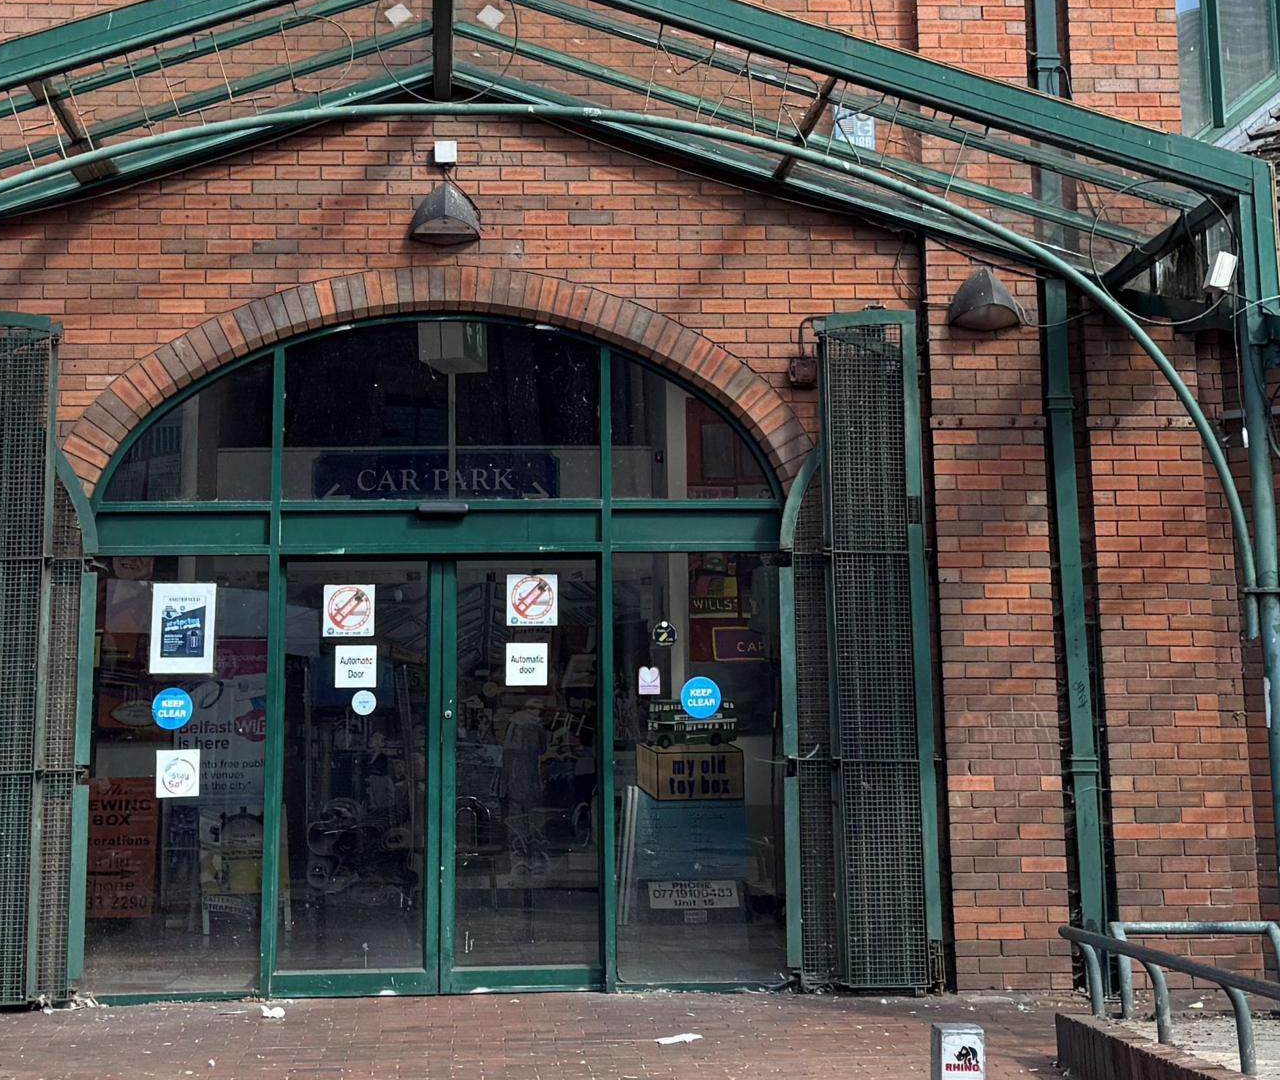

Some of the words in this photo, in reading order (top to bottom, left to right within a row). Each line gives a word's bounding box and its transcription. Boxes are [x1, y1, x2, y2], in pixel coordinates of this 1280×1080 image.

[356, 468, 420, 492] CAR
[433, 468, 516, 492] PARK
[339, 656, 373, 665] Automatic
[510, 655, 544, 664] Automatic
[347, 669, 365, 679] Door
[519, 666, 535, 674] door
[689, 688, 712, 697] KEEP
[161, 699, 185, 708] KEEP
[687, 698, 715, 707] CLEAR
[158, 709, 186, 718] CLEAR
[179, 737, 189, 749] is
[195, 736, 230, 750] here
[220, 760, 239, 769] free
[672, 759, 694, 777] my
[701, 755, 726, 774] old
[211, 781, 227, 790] the
[670, 777, 695, 797] toy
[701, 776, 730, 794] box
[88, 799, 152, 811] EWING
[92, 814, 131, 826] BOX
[671, 881, 713, 889] PHONE
[674, 899, 696, 907] Unit
[945, 1063, 980, 1072] RHINO
